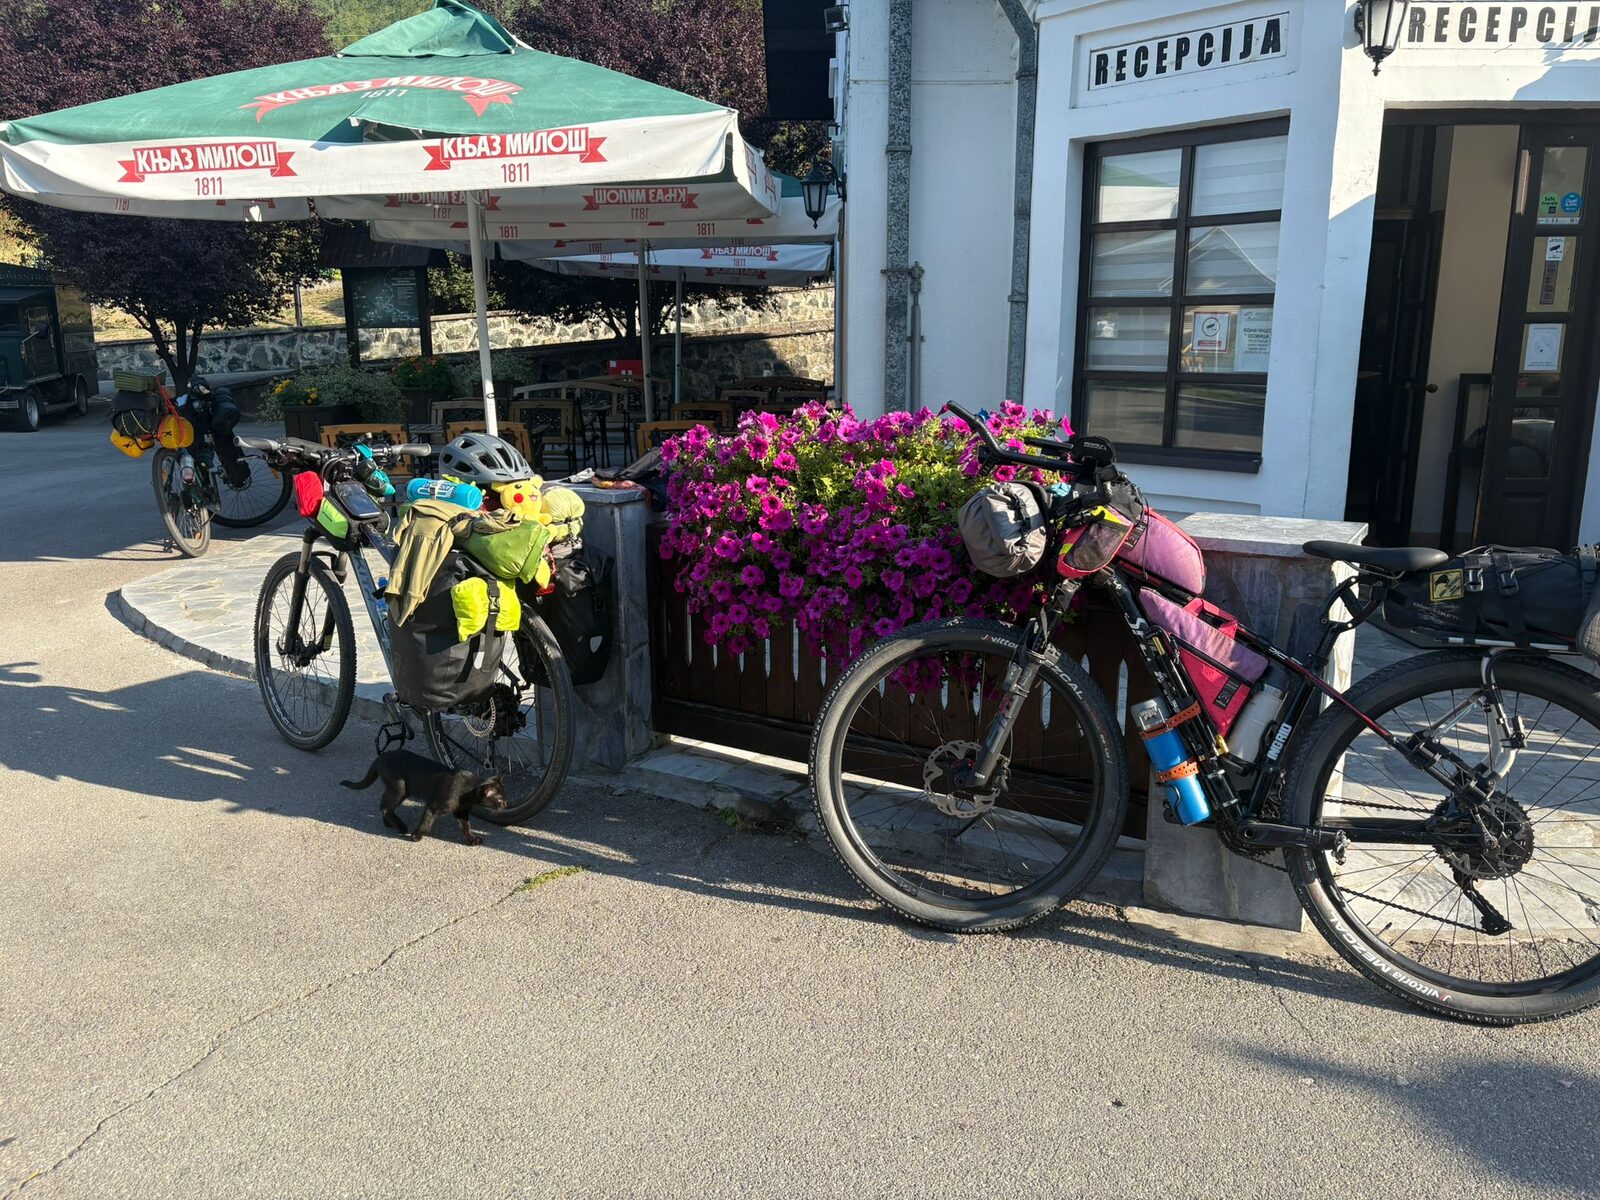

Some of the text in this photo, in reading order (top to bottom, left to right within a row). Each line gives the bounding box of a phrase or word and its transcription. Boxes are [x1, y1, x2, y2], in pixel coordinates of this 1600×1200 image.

[1095, 18, 1281, 86] RECEPCIJA
[265, 76, 514, 102] КЊАЗ МИЛОШ
[360, 89, 409, 99] 1811
[442, 129, 587, 159] КЊАЗ МИЛОШ
[135, 143, 276, 173] КЊАЗ МИЛОШ
[500, 162, 530, 183] 1811
[194, 176, 223, 196] 1811
[500, 225, 519, 239] 1811
[696, 223, 716, 236] 1811
[709, 246, 771, 257] КЊАЗ МИЛОШ
[733, 258, 746, 267] 1811
[1267, 722, 1293, 760] INGRID
[1330, 917, 1440, 999] vittoria MEZCAL
